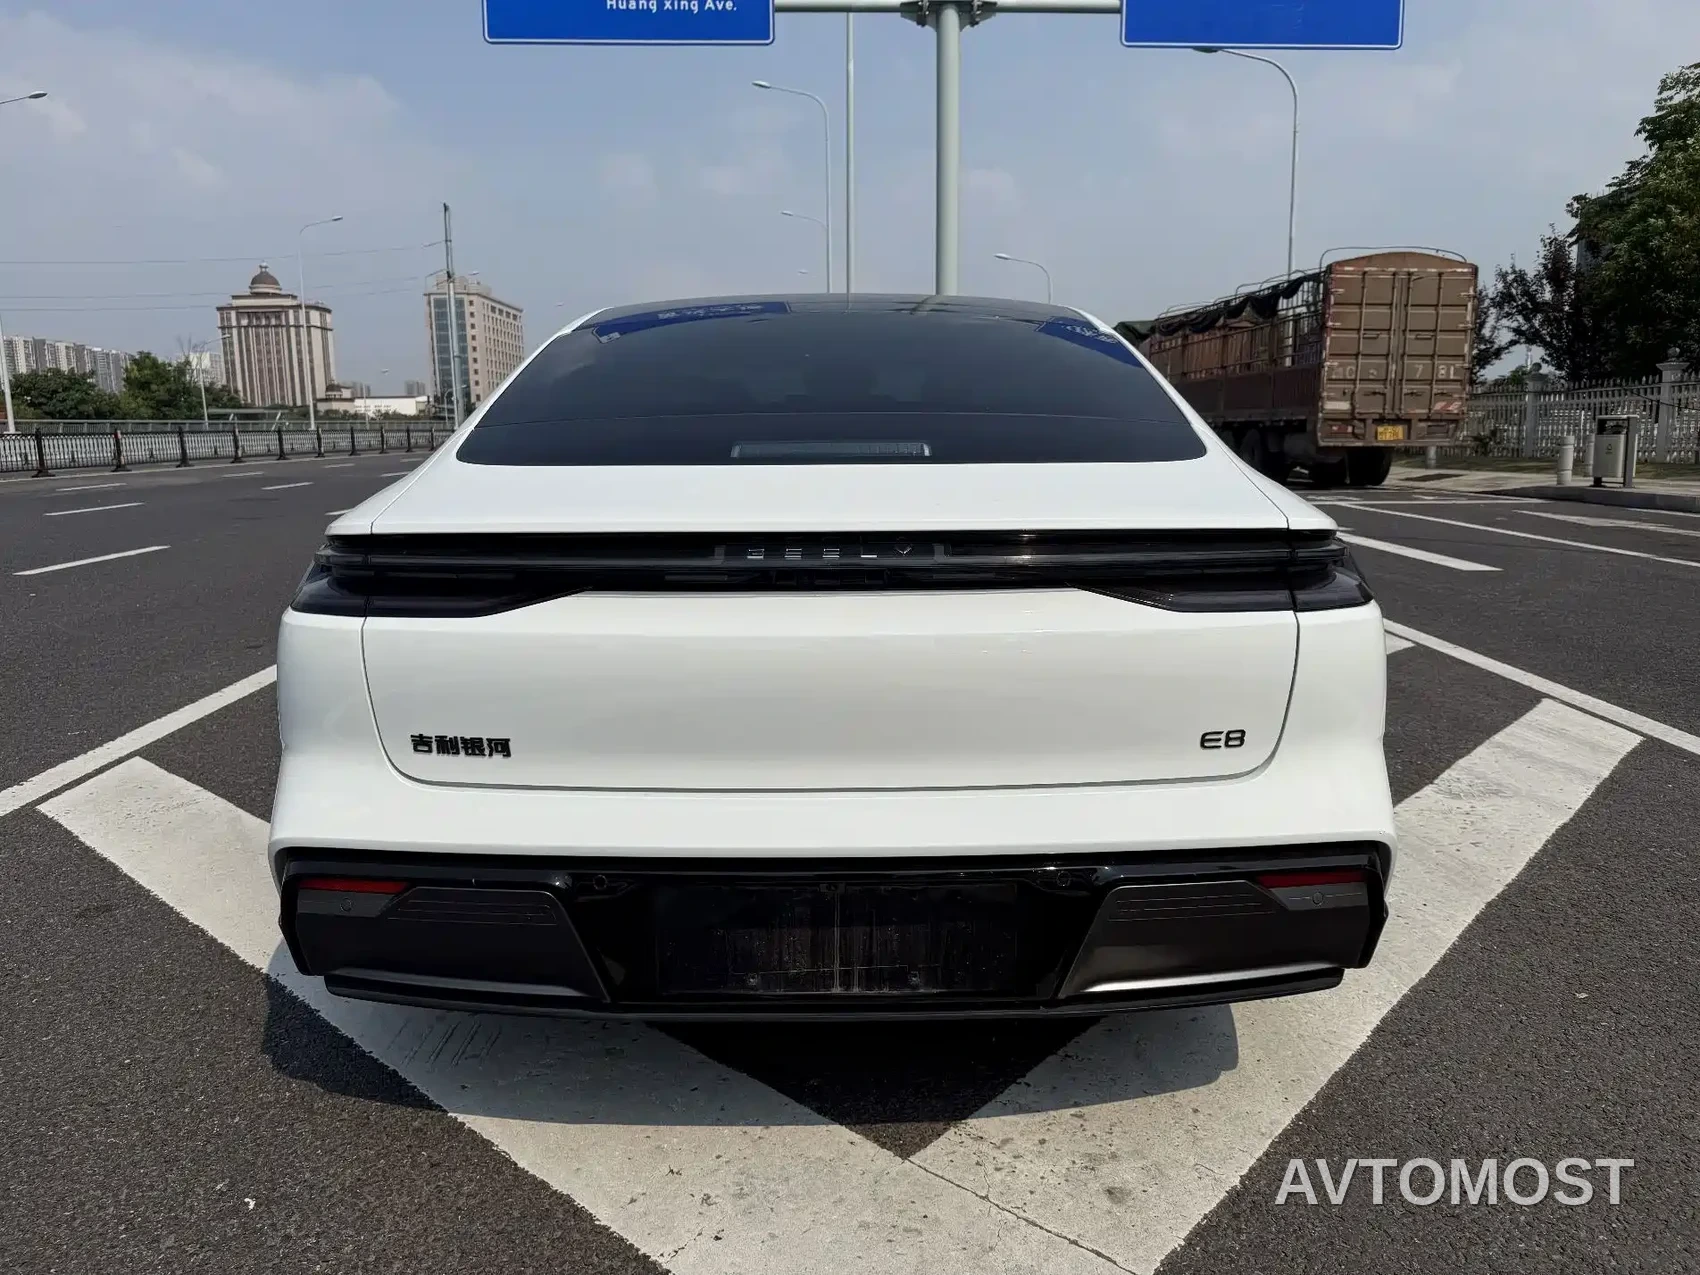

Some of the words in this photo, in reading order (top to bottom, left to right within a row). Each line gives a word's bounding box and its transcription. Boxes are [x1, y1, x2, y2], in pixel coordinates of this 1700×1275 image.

[606, 0, 657, 13] Huang
[704, 0, 737, 11] Ave.
[410, 733, 512, 758] 吉利银河
[1200, 729, 1246, 749] E8
